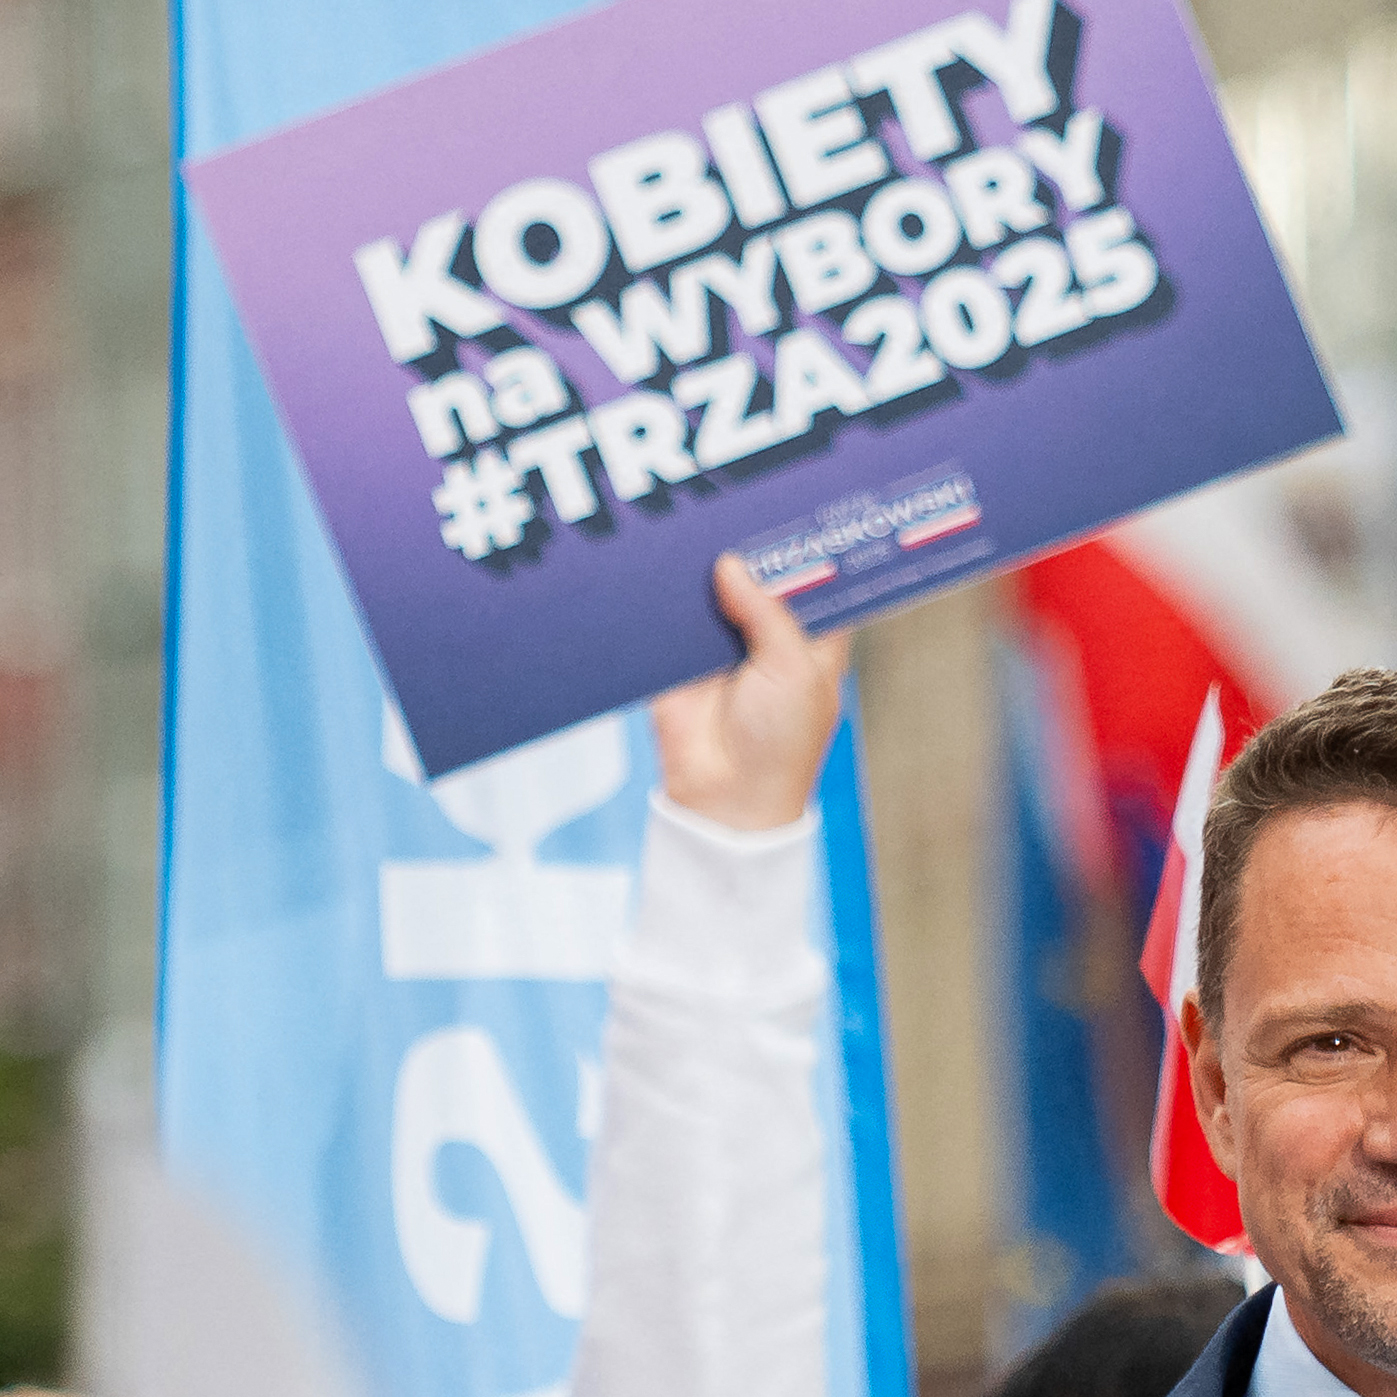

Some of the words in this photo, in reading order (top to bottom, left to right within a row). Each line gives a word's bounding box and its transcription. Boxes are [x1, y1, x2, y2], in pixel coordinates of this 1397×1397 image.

[350, 0, 1062, 365] KOBIETY
[403, 346, 570, 461] na
[570, 104, 1107, 388] WYBORY
[428, 205, 1160, 562] #TRZA2025
